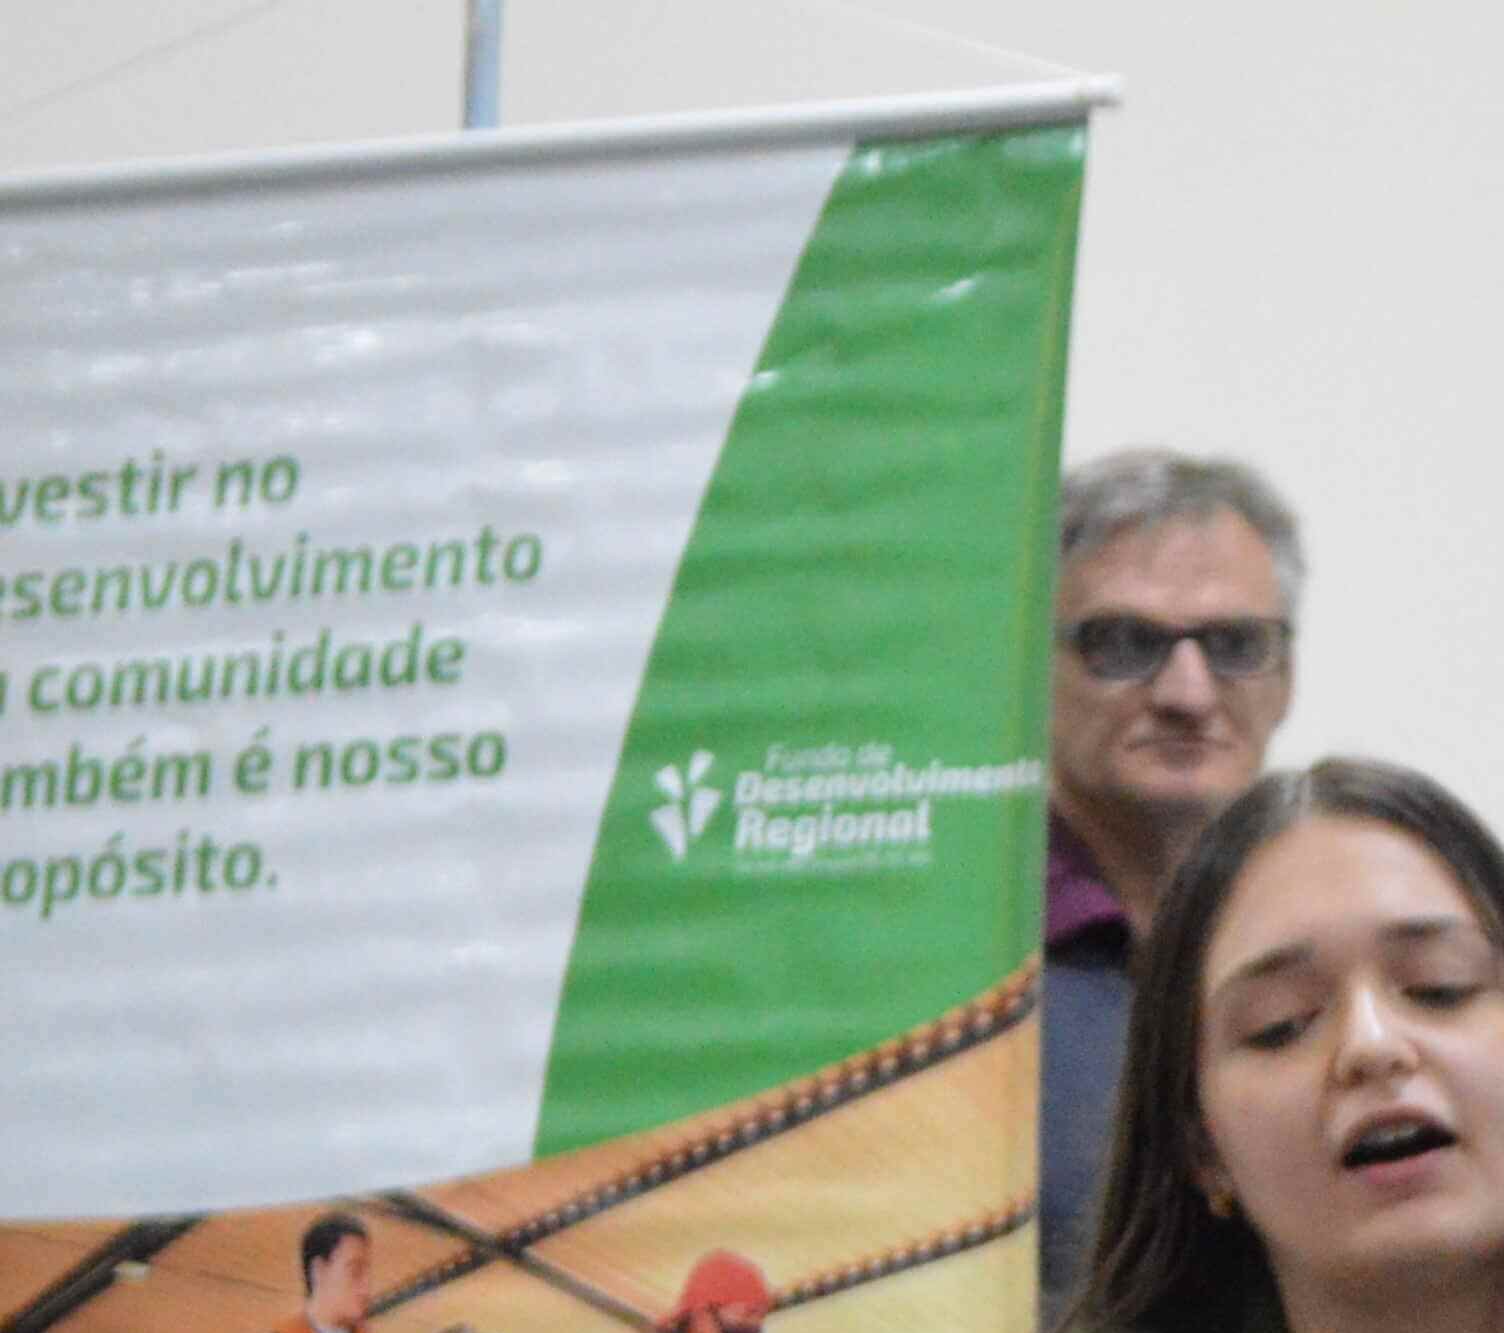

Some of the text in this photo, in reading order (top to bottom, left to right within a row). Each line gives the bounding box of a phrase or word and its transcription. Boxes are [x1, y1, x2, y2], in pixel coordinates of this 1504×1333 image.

[213, 455, 299, 508] no
[0, 524, 543, 620] senvolvimento
[28, 621, 467, 712] comunidade
[235, 724, 274, 795] é
[292, 729, 508, 790] nosso
[735, 758, 1041, 806] Desenvolvimento
[735, 798, 931, 858] Regional
